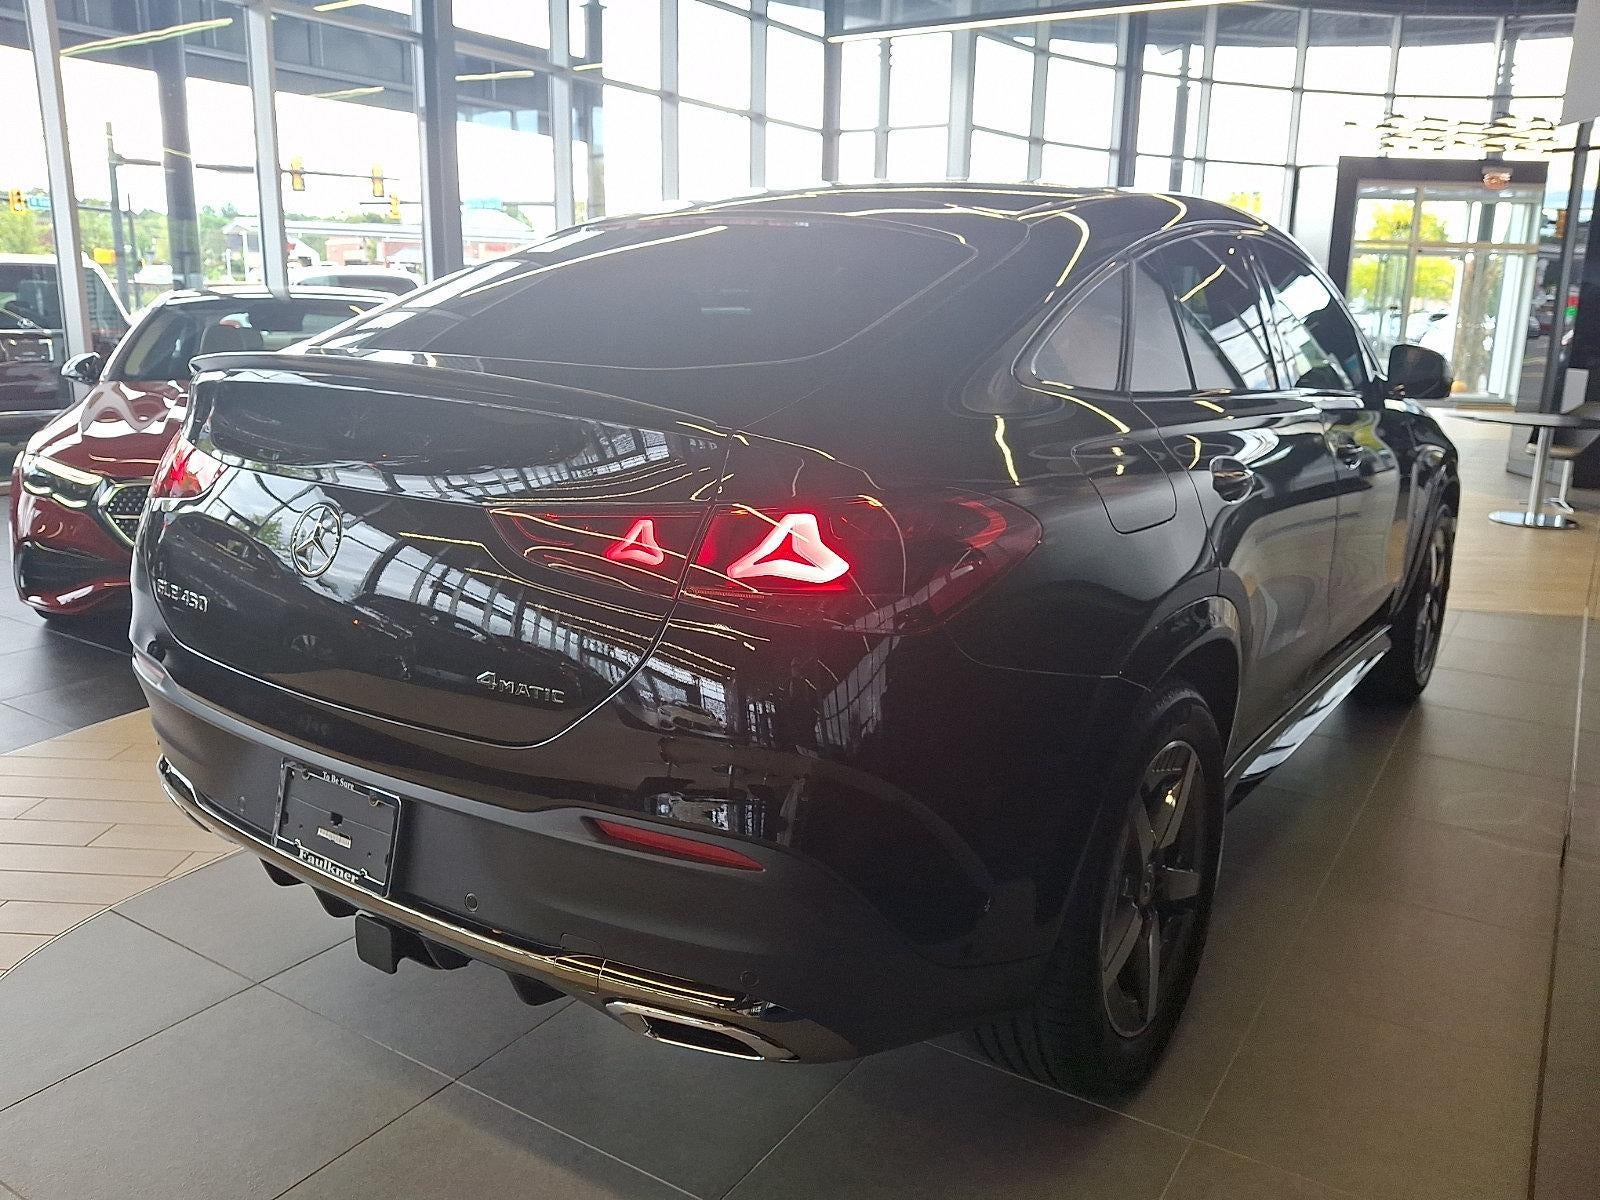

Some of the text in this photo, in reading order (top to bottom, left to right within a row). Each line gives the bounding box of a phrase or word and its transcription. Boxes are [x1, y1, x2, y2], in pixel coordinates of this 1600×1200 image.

[476, 671, 565, 704] 4MATIC
[322, 770, 355, 791] To Be Sure
[299, 849, 359, 884] Faulkner
